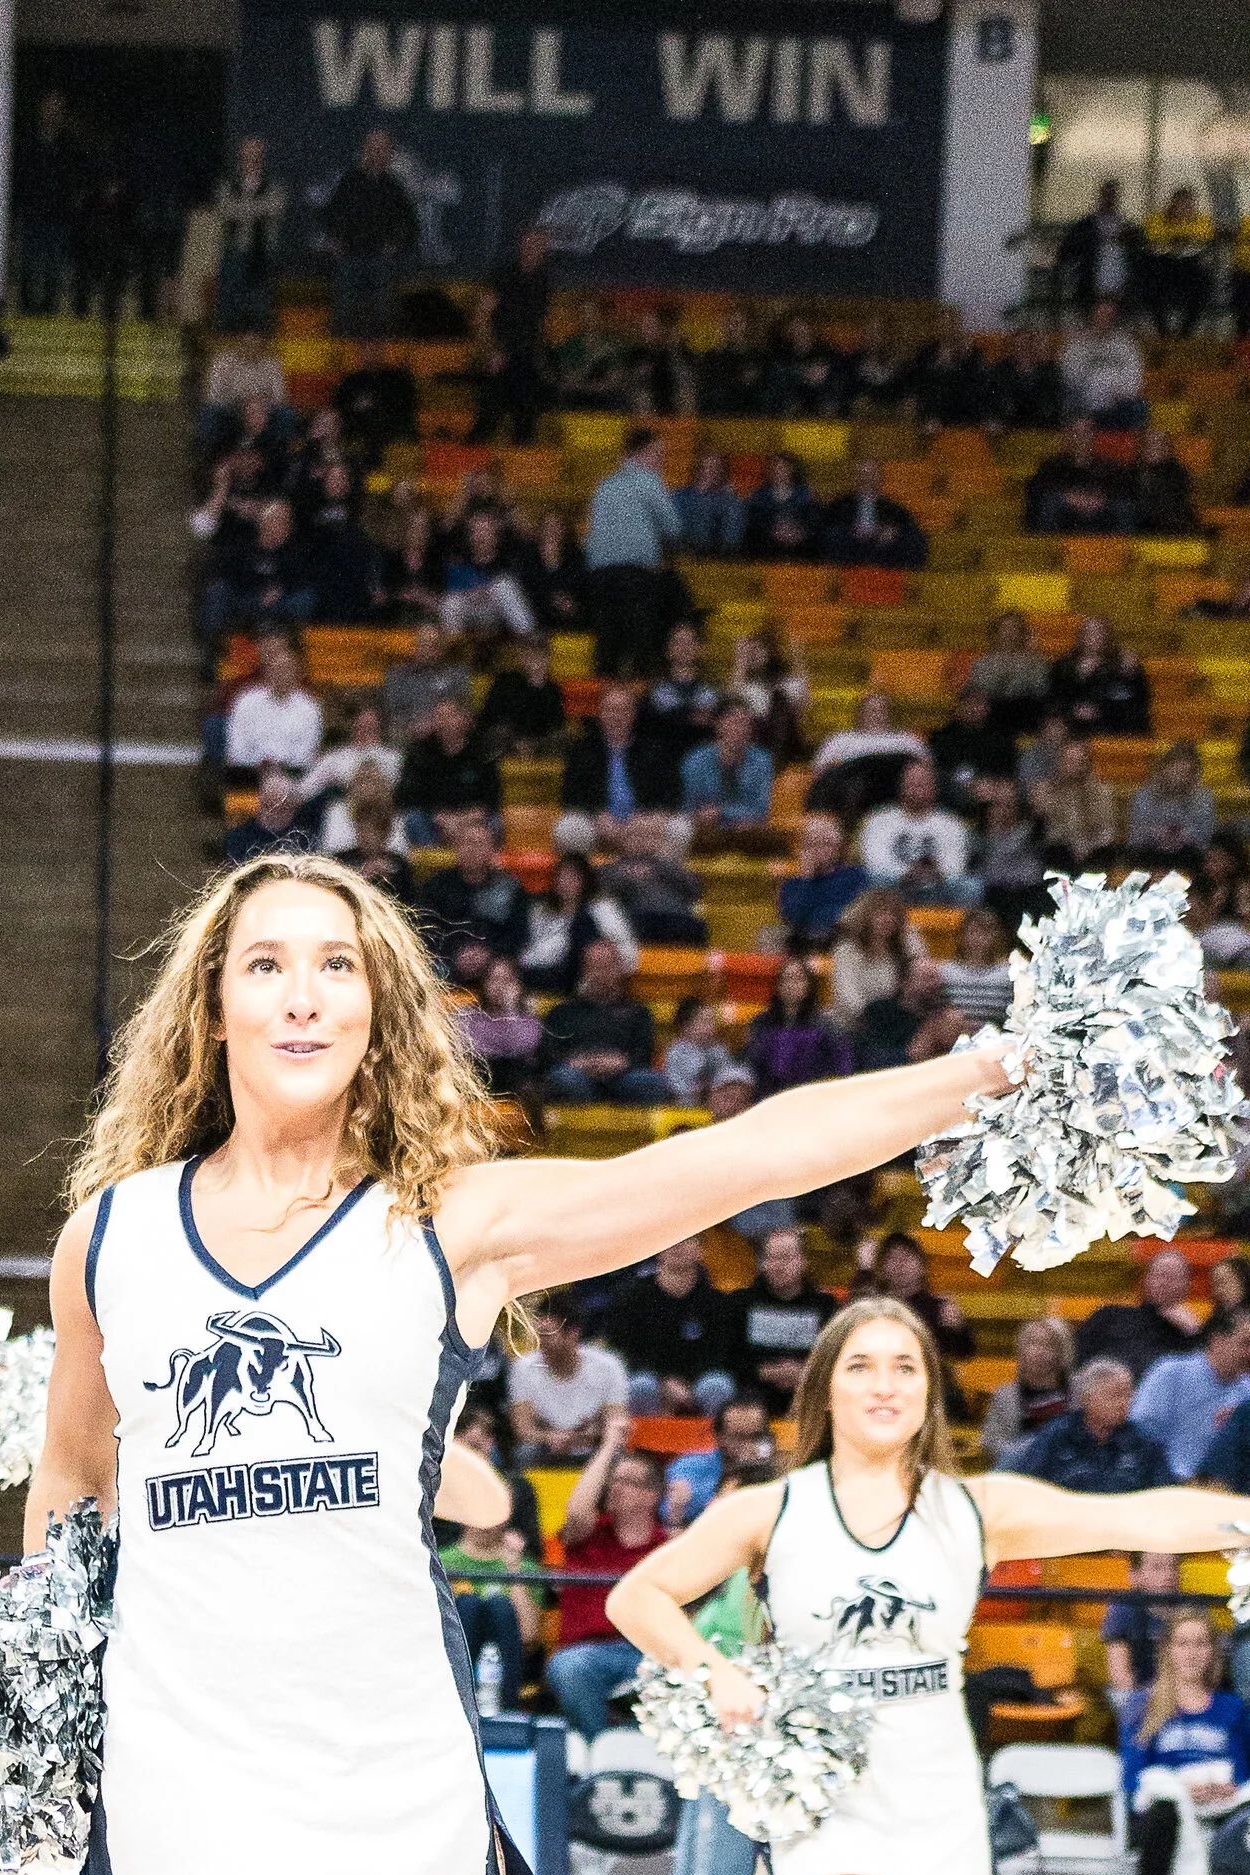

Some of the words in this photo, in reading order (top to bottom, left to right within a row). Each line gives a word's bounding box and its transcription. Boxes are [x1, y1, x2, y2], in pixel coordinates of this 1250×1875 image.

[312, 19, 595, 115] WILL
[657, 30, 893, 127] WIN
[976, 17, 1014, 63] B
